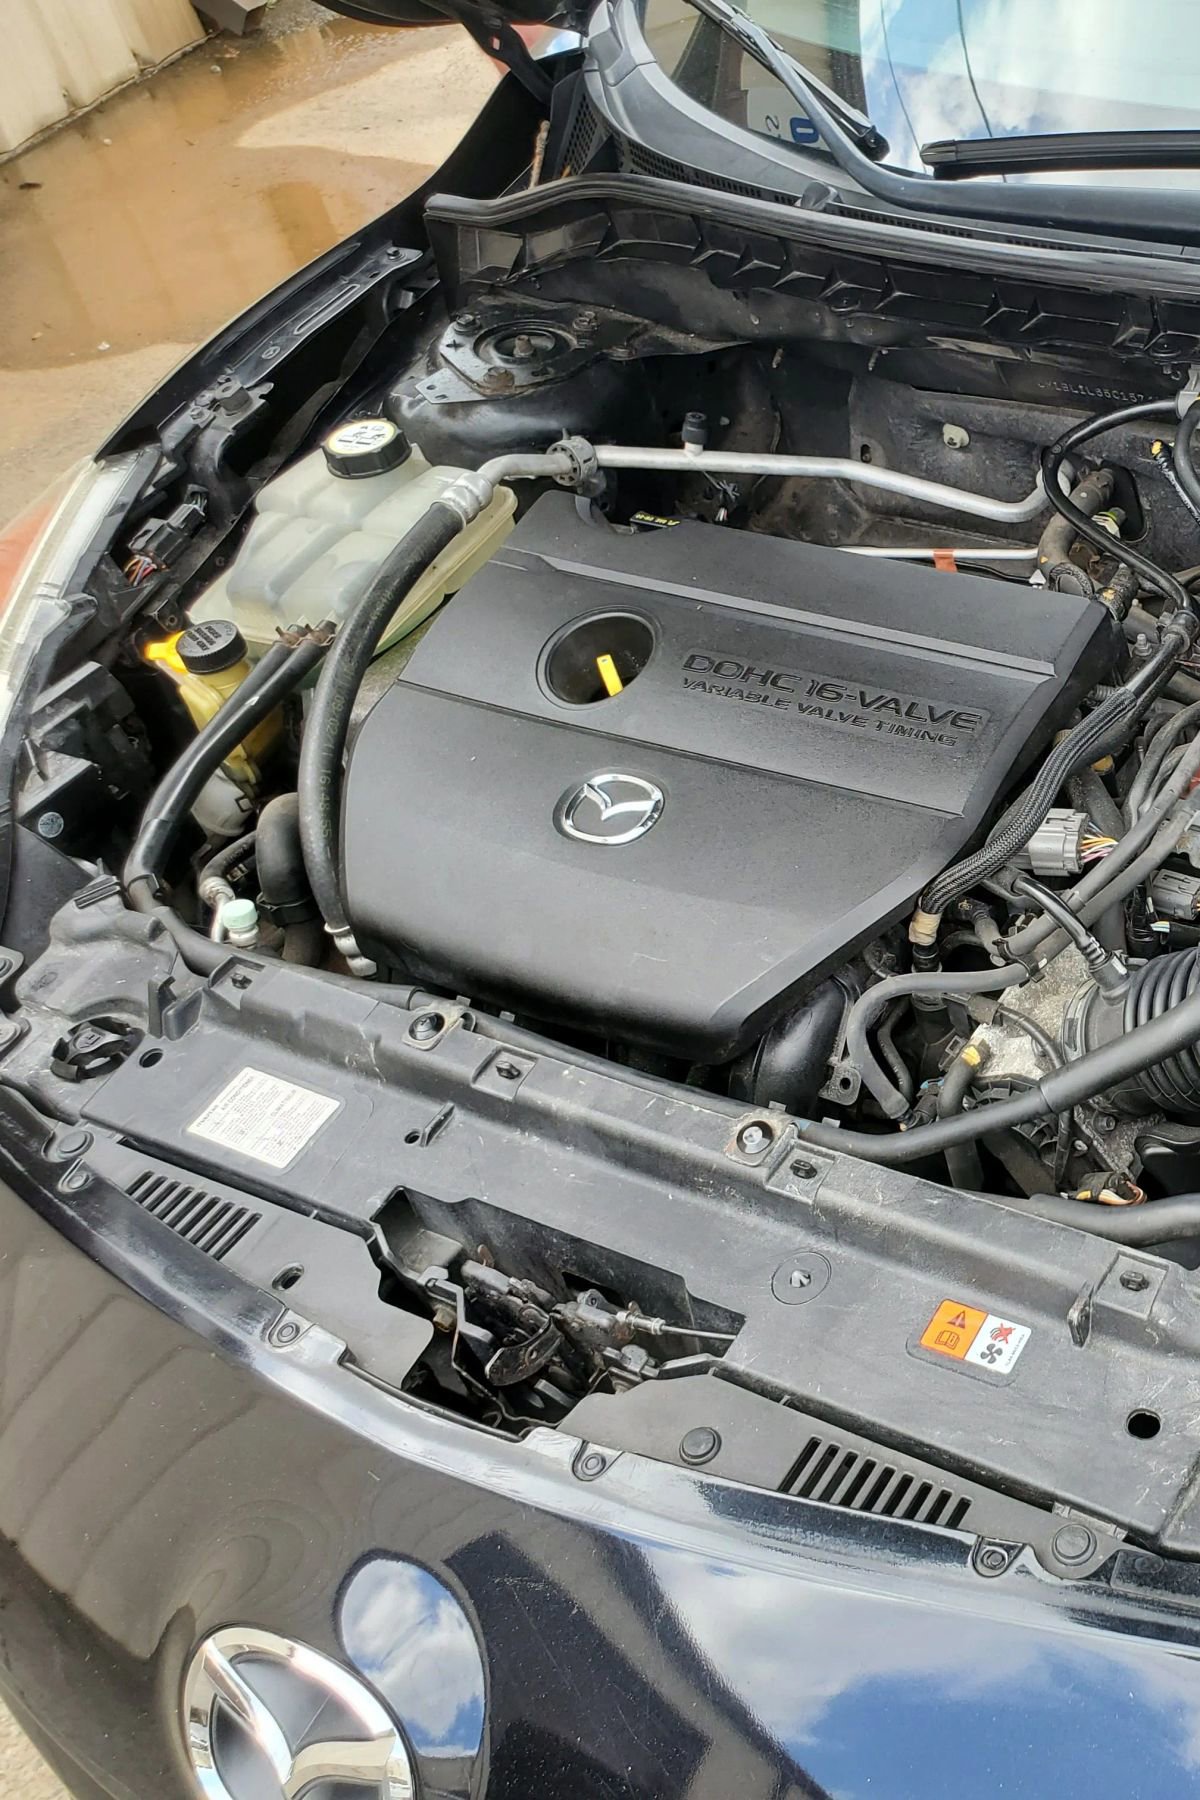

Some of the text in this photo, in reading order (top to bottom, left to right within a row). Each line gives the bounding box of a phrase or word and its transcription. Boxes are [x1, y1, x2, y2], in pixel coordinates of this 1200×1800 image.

[681, 653, 982, 731] DOHC 16-VALVE
[682, 676, 958, 747] VARIABLE VALVE TIMING
